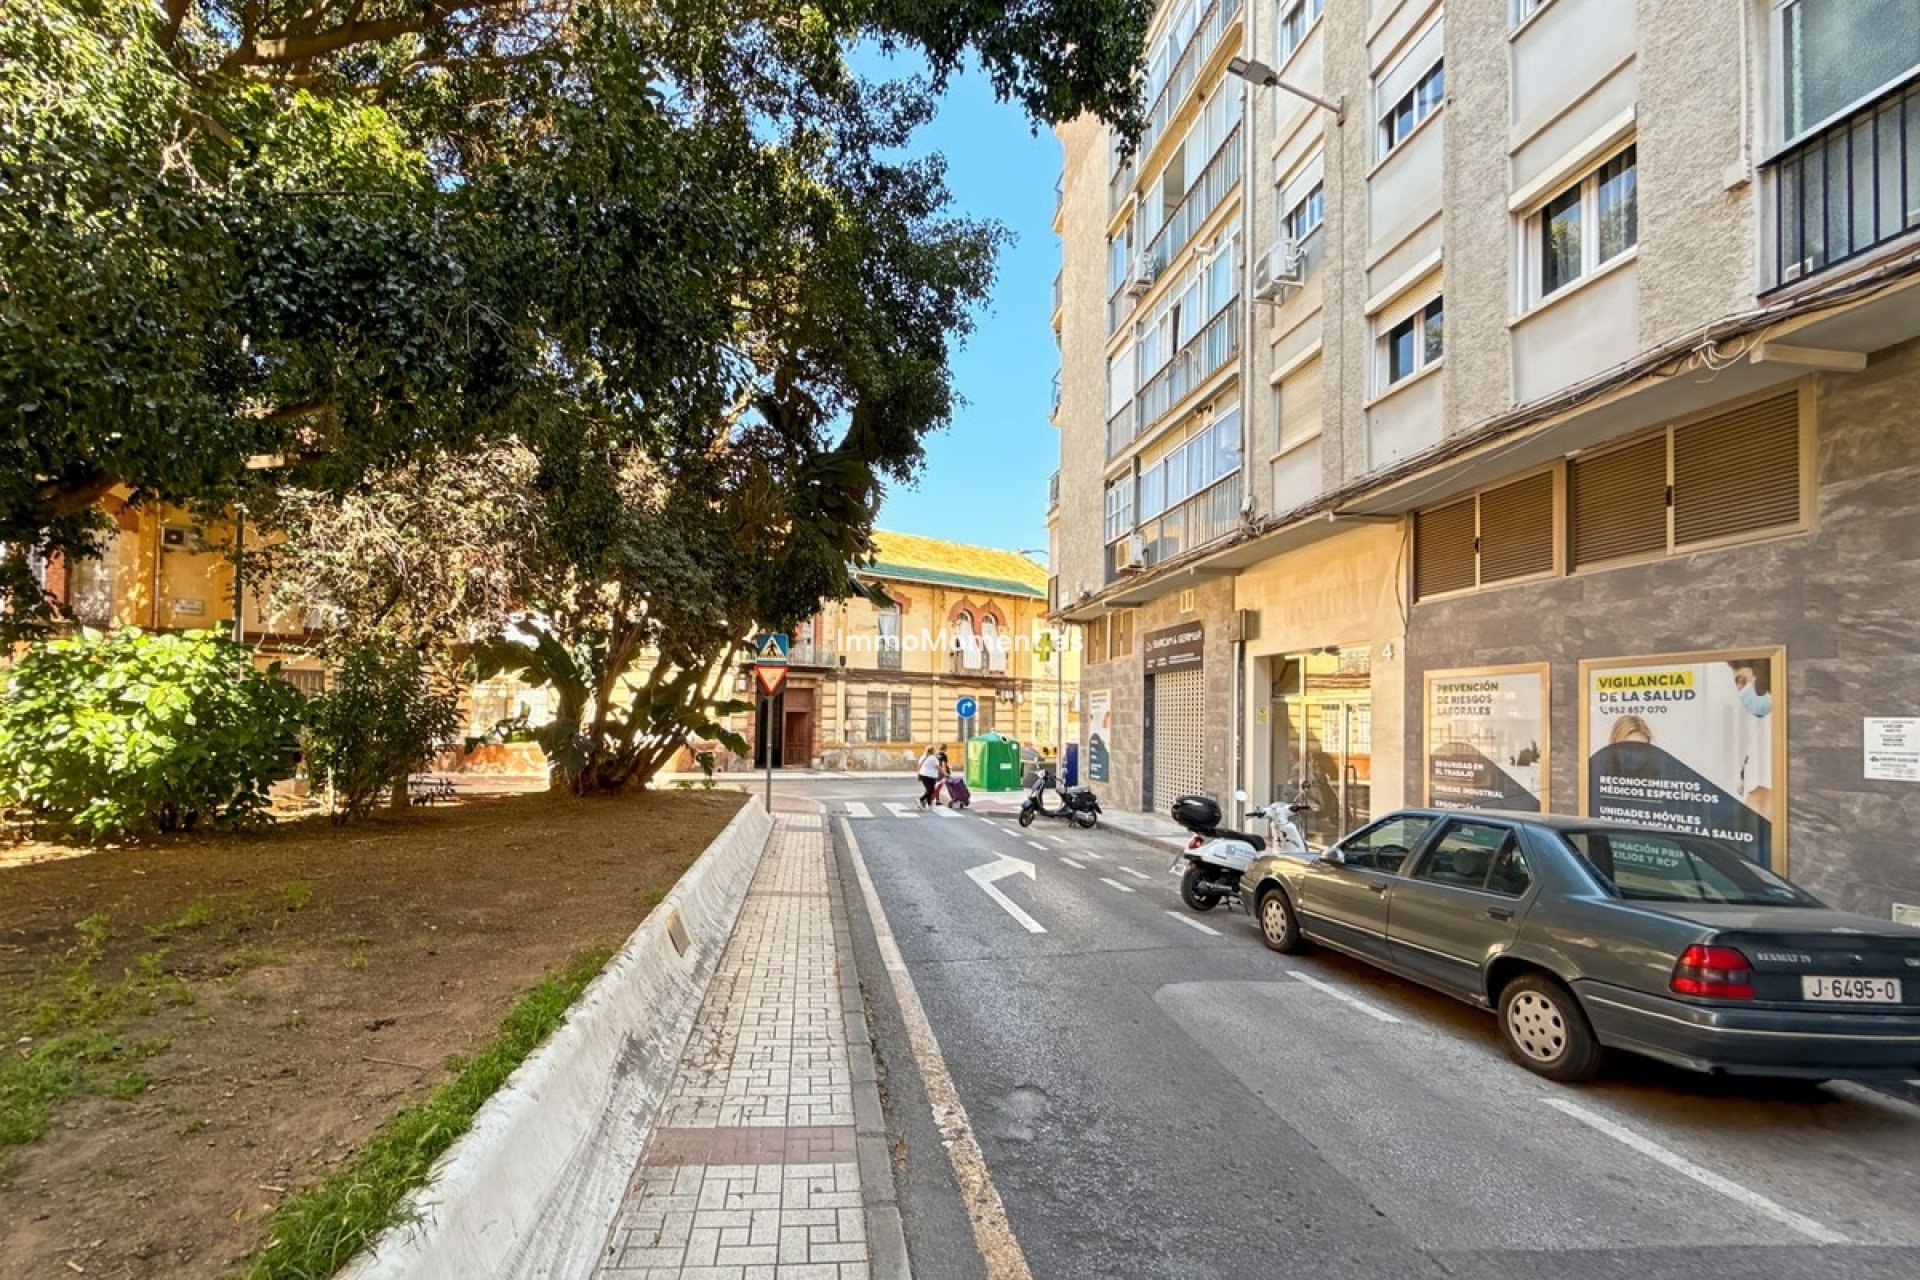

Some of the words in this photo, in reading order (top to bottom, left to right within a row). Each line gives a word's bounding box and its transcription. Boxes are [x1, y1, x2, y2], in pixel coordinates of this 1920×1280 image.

[1382, 643, 1394, 660] 4
[1436, 680, 1499, 692] PREVENCIÓN
[1598, 674, 1686, 689] VIGILANCIA
[1450, 694, 1493, 705] RIESGOS
[1600, 692, 1618, 702] DE
[1621, 691, 1640, 701] LA
[1643, 689, 1696, 701] SALUD
[1608, 705, 1625, 714] 952
[1647, 705, 1668, 714] 070
[1600, 776, 1700, 791] RECONOCIMIENTOS
[1600, 784, 1644, 797] MÉDICOS
[1647, 789, 1719, 804] ESPECÍFICOS
[1600, 806, 1651, 819] UNIDADES
[1652, 810, 1701, 825] MÓVILES
[1695, 827, 1710, 837] LA
[1712, 828, 1753, 843] SALUD
[1645, 855, 1653, 864] Y
[1656, 857, 1679, 868] RCP
